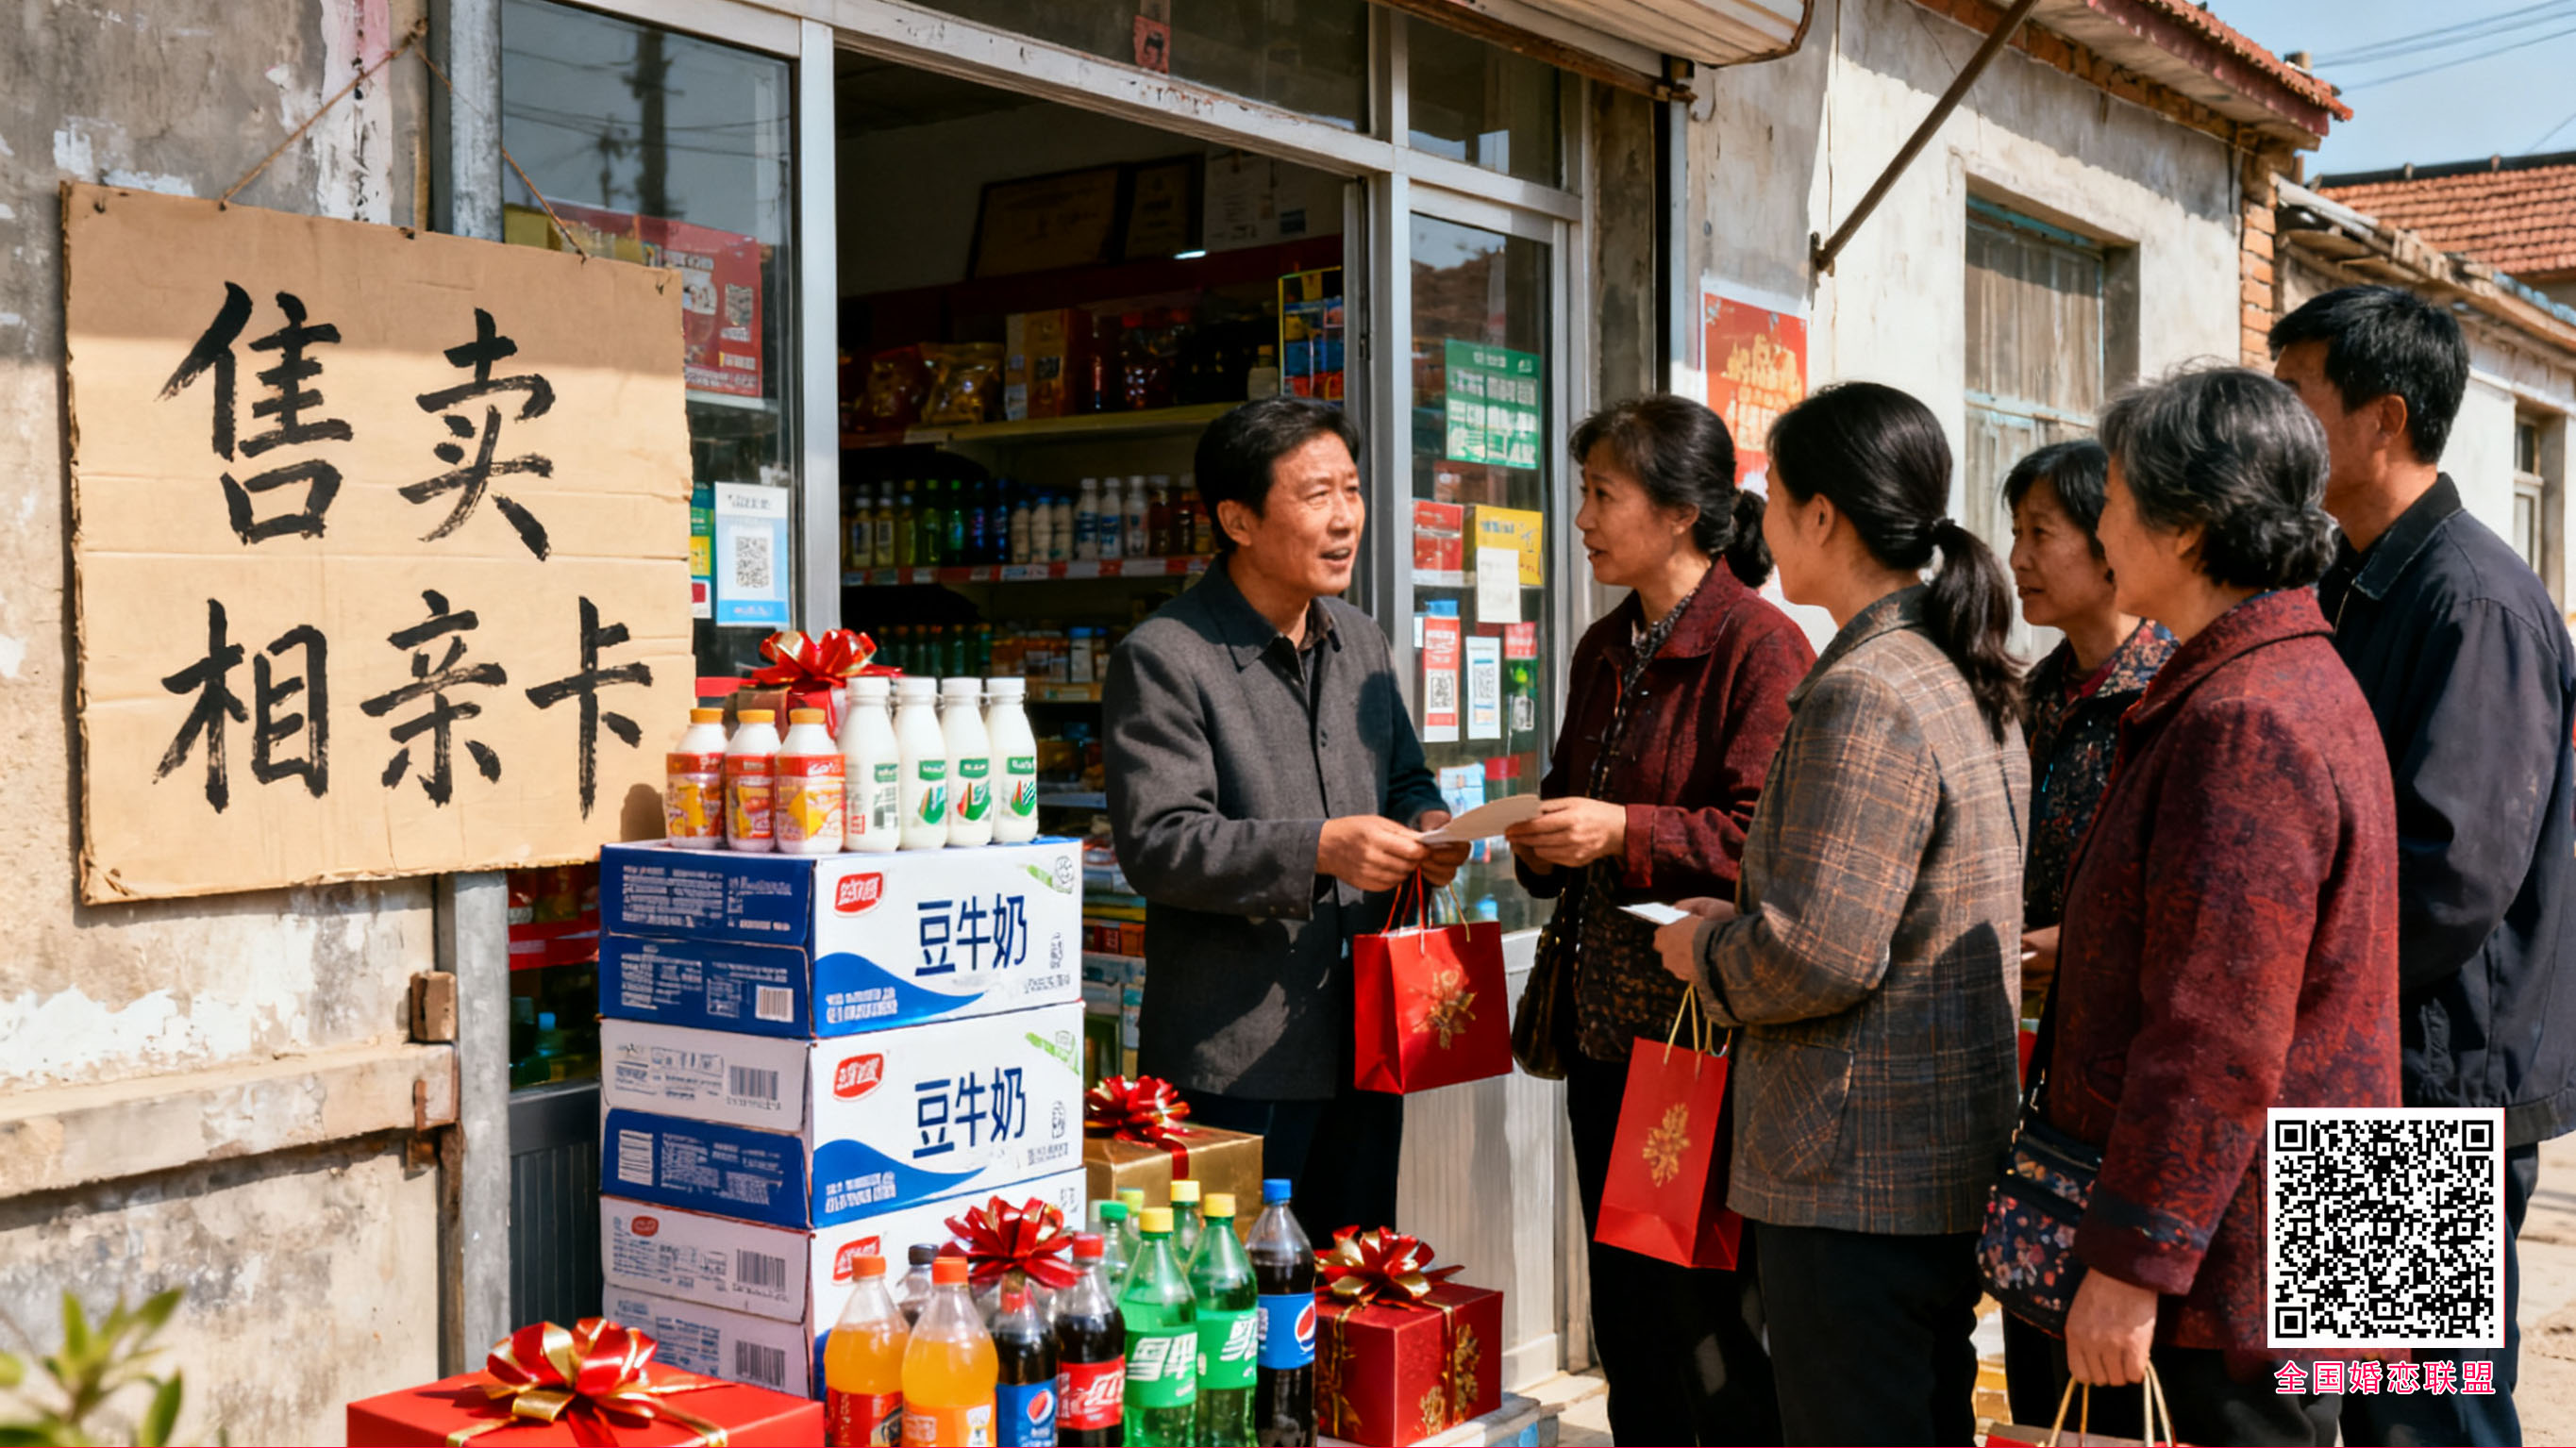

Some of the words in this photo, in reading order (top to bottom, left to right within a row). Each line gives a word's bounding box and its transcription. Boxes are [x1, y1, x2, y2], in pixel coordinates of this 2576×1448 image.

[154, 281, 557, 561] 售卖
[153, 590, 654, 823] 相亲卡
[914, 892, 1028, 977] 豆牛奶
[912, 1067, 1027, 1159] 豆牛奶
